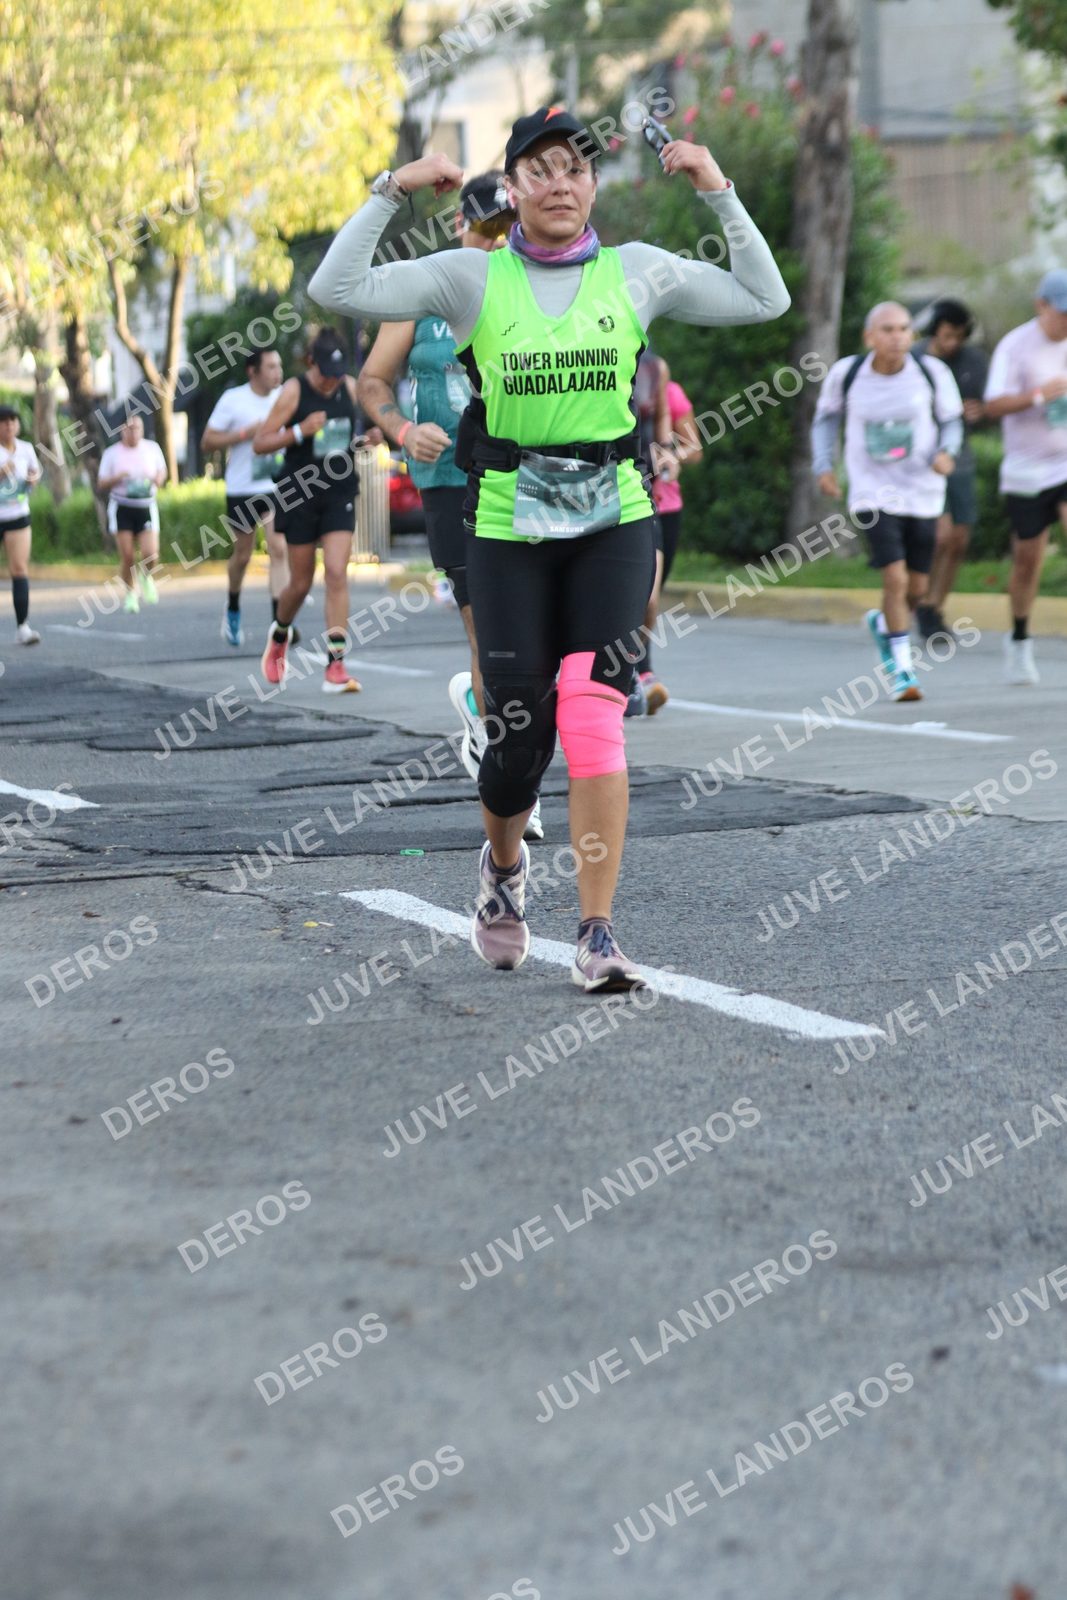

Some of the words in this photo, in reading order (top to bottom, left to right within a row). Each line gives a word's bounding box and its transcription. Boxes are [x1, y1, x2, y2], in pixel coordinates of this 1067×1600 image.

[501, 352, 551, 371] TOWER
[555, 348, 618, 369] RUNNING
[503, 371, 617, 396] GUADALAJARA
